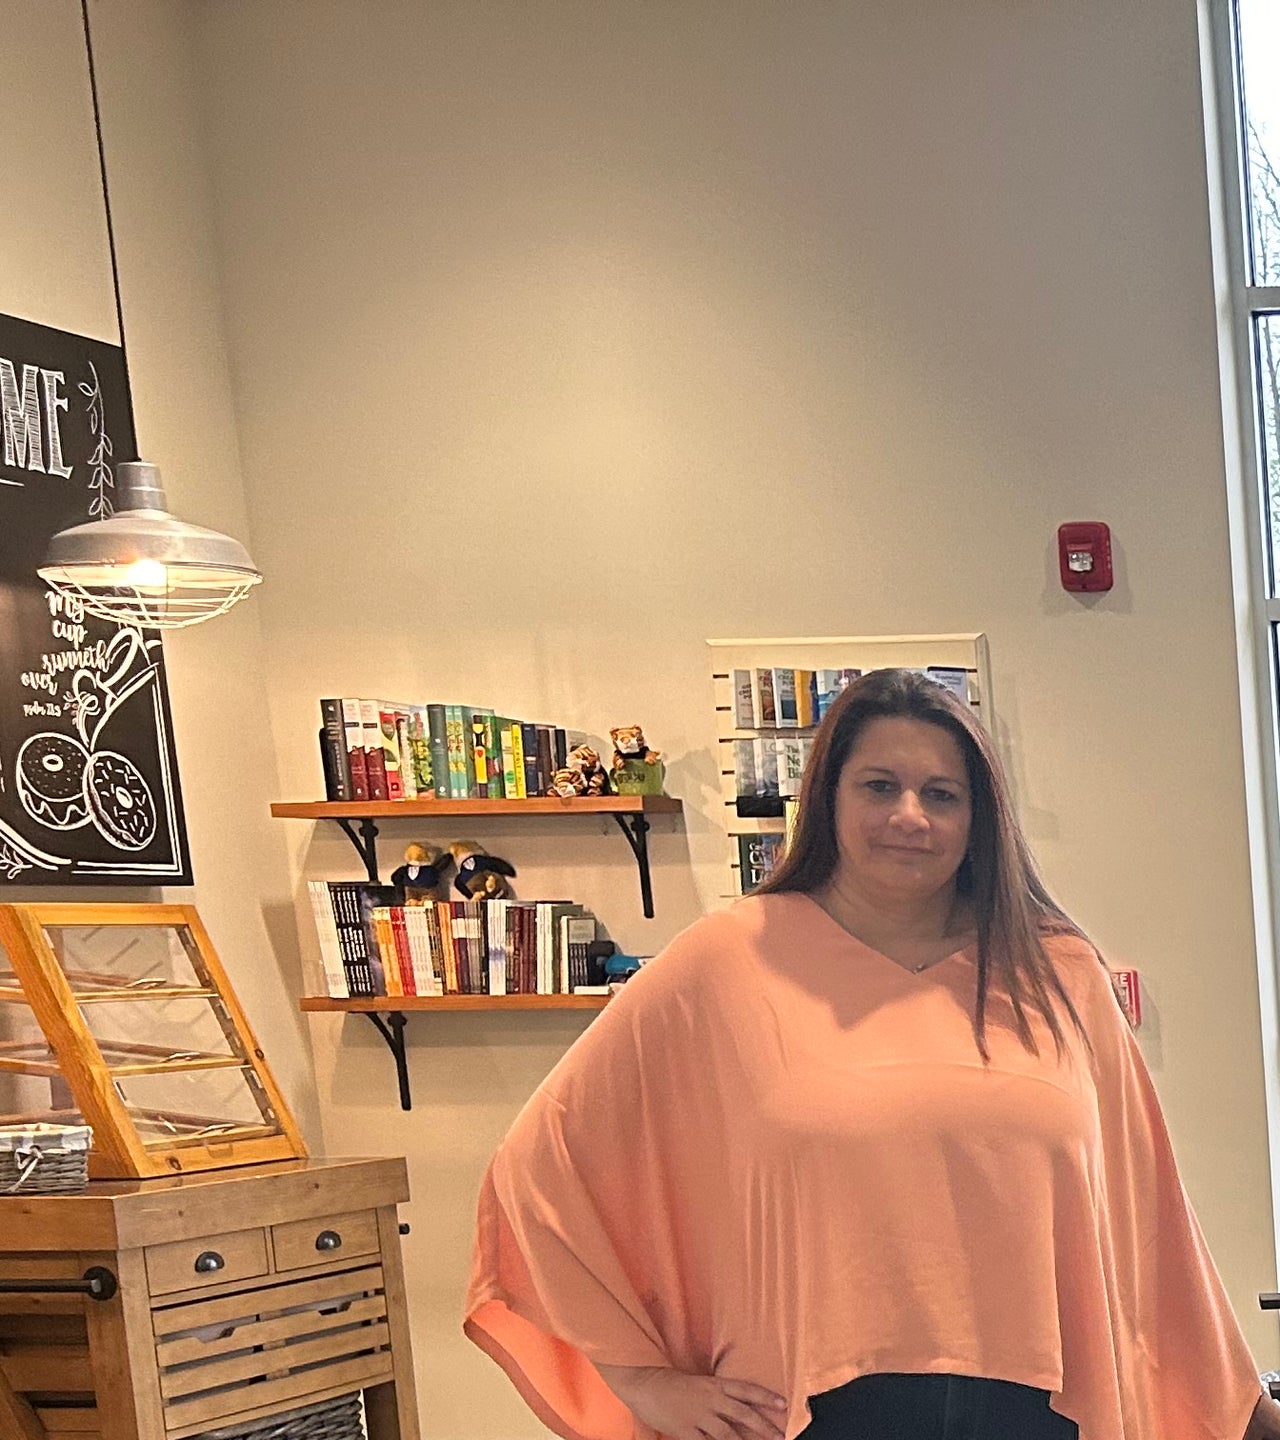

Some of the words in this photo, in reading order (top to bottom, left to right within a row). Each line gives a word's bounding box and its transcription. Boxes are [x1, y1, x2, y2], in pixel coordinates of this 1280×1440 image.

[0, 357, 73, 479] ME
[52, 620, 88, 651] cup
[41, 640, 111, 676] runneth
[20, 671, 58, 696] over
